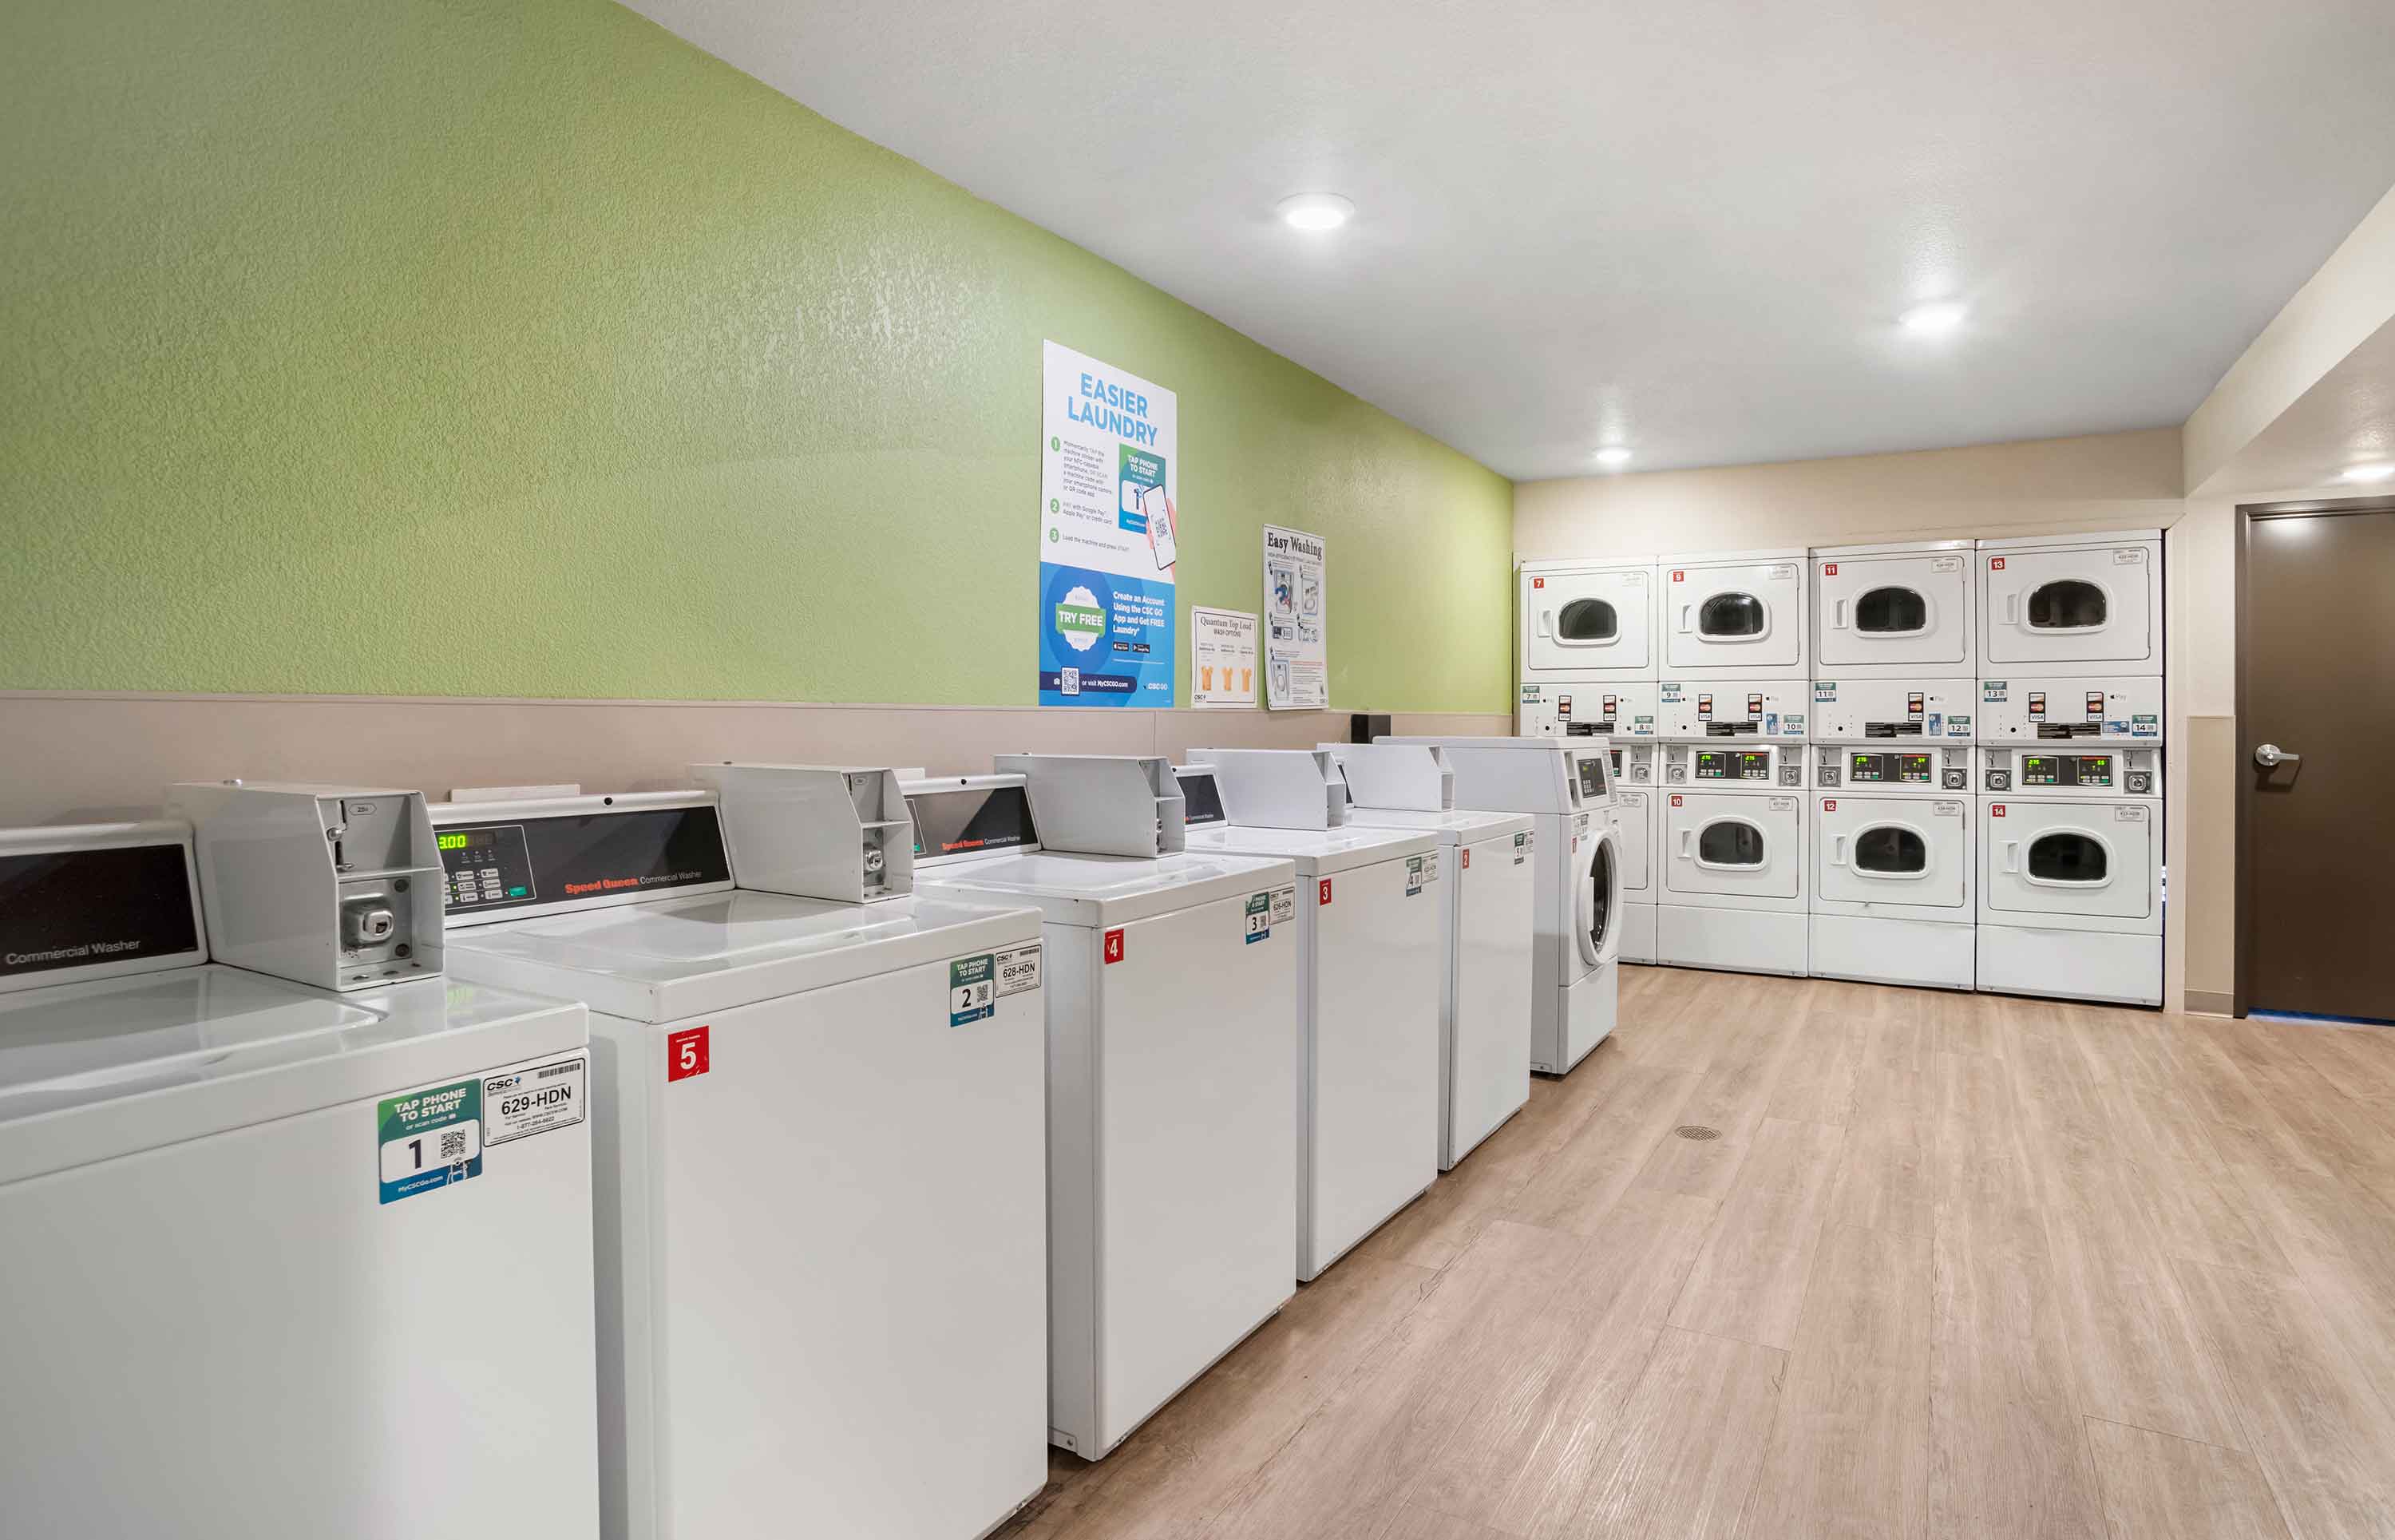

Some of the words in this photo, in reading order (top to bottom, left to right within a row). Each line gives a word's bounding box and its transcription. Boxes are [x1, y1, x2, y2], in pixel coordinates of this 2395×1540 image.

[1081, 372, 1148, 418] EASIER
[1068, 396, 1158, 447] LAUNDRY
[1128, 454, 1138, 465] TAP
[1139, 458, 1158, 471] PHONE
[1139, 466, 1156, 477] START
[1268, 532, 1289, 553] Easy
[1290, 536, 1322, 561] Washing
[1113, 591, 1133, 601] Create
[1142, 596, 1166, 607] Account
[1114, 602, 1130, 614] Using
[1131, 604, 1141, 613] the
[1059, 610, 1078, 624] TRY
[1079, 614, 1103, 627] FREE
[1113, 613, 1126, 624] App
[1139, 616, 1150, 626] Get
[1150, 618, 1166, 627] FREE
[1200, 616, 1228, 628] Quantum
[1229, 620, 1239, 631] Top
[1240, 620, 1252, 631] Load
[1225, 629, 1241, 638] OPTIONS
[942, 841, 964, 851] Speed
[964, 839, 984, 848] Queen
[564, 881, 601, 895] Speed
[603, 877, 639, 889] Queen
[639, 873, 679, 885] Commercial
[679, 870, 703, 880] Washer
[1322, 886, 1328, 901] 3
[1252, 916, 1257, 931] 3
[6, 944, 89, 965] Commercial
[91, 940, 141, 954] Washer
[1110, 938, 1118, 957] 4
[969, 958, 988, 968] PHONE
[996, 954, 1009, 963] CSC
[968, 966, 986, 976] START
[1003, 963, 1035, 979] 628-HDN
[962, 988, 971, 1008] 2
[680, 1041, 697, 1070] 5
[487, 1079, 513, 1091] CSC
[394, 1099, 420, 1113] TAP
[422, 1088, 467, 1107] PHONE
[501, 1086, 572, 1115] 629-HDN
[400, 1112, 418, 1122] TO
[422, 1099, 462, 1118] START
[431, 1115, 448, 1124] code
[408, 1138, 422, 1170] 1
[398, 1175, 444, 1194] MyCSCGo.com
